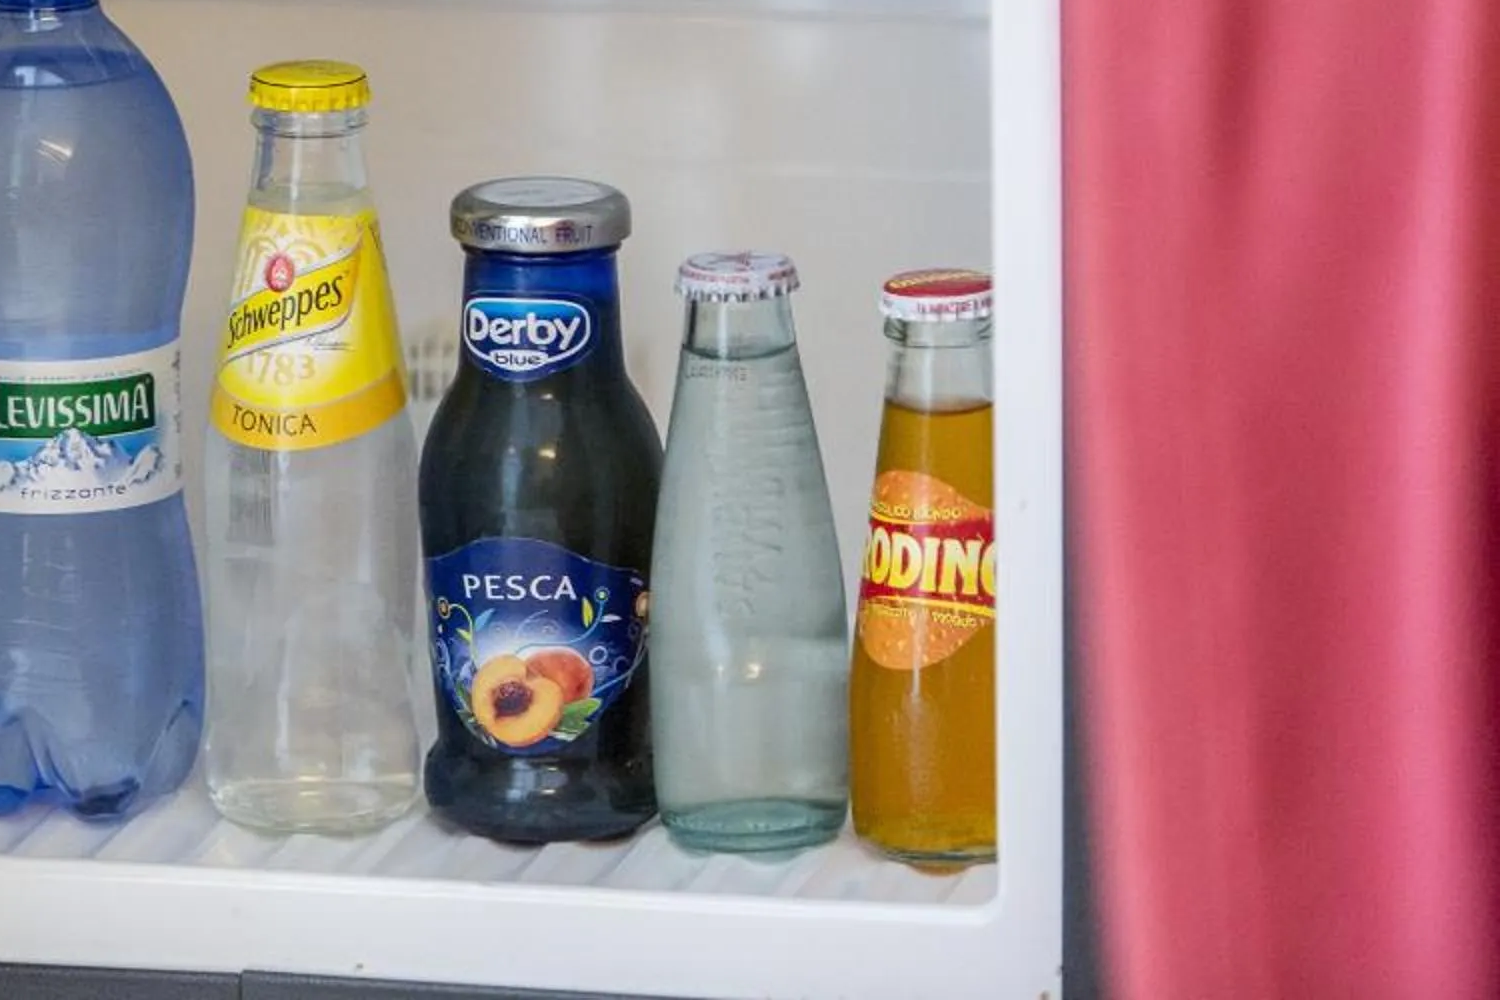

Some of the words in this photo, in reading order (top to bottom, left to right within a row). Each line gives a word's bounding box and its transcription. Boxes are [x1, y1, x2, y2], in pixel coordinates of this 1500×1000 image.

[227, 275, 344, 349] Schweppes
[469, 308, 581, 351] Derby
[247, 351, 317, 387] 1783
[493, 351, 543, 366] blue
[232, 404, 317, 437] TONICA
[20, 484, 128, 501] frizzante
[462, 574, 578, 601] PESCA
